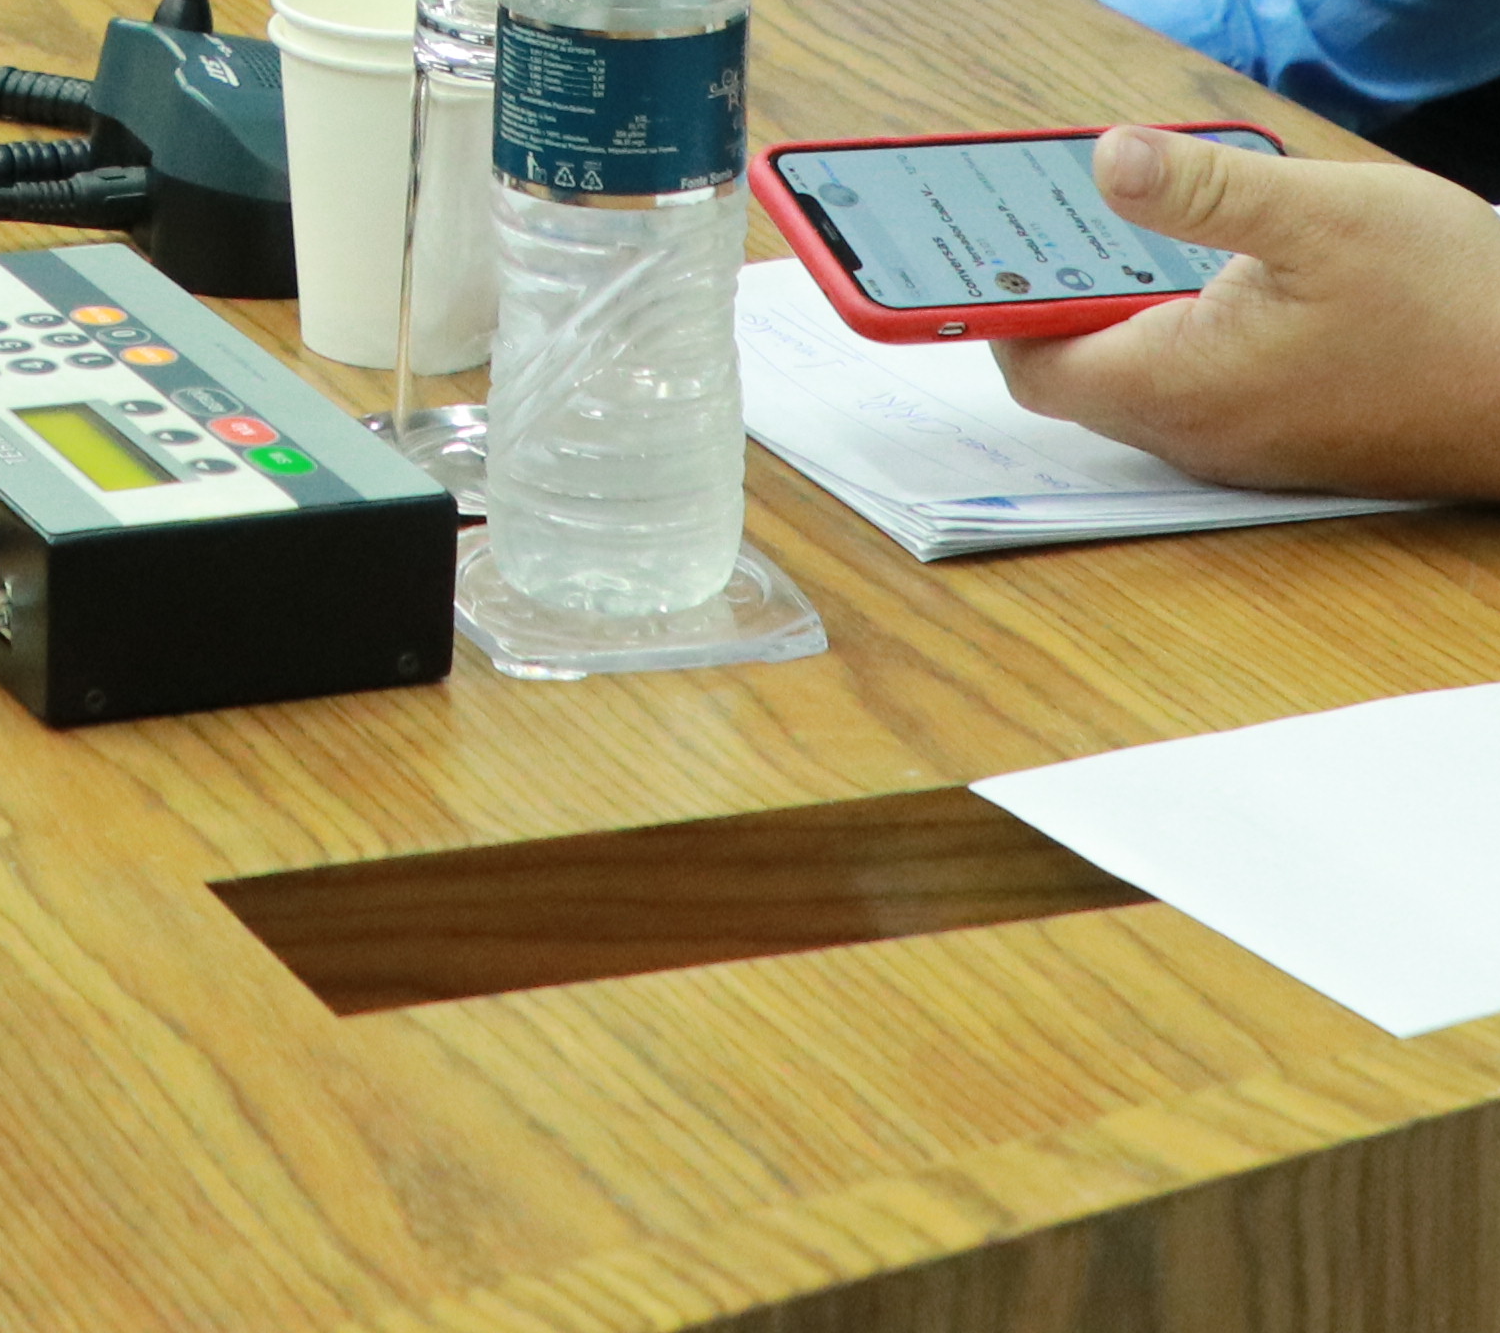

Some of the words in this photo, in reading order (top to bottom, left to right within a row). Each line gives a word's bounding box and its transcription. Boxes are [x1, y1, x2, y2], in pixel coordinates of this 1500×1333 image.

[680, 175, 709, 190] Fonte
[930, 198, 953, 223] Cadu
[1066, 207, 1091, 234] Maria
[948, 224, 985, 267] Vereador
[1025, 238, 1048, 263] Cadu
[1087, 235, 1110, 259] Cadu
[932, 236, 983, 298] Conversas
[29, 315, 55, 324] 3
[54, 334, 81, 343] 2
[111, 329, 137, 338] 0
[19, 361, 46, 370] 4
[78, 356, 104, 364] 1
